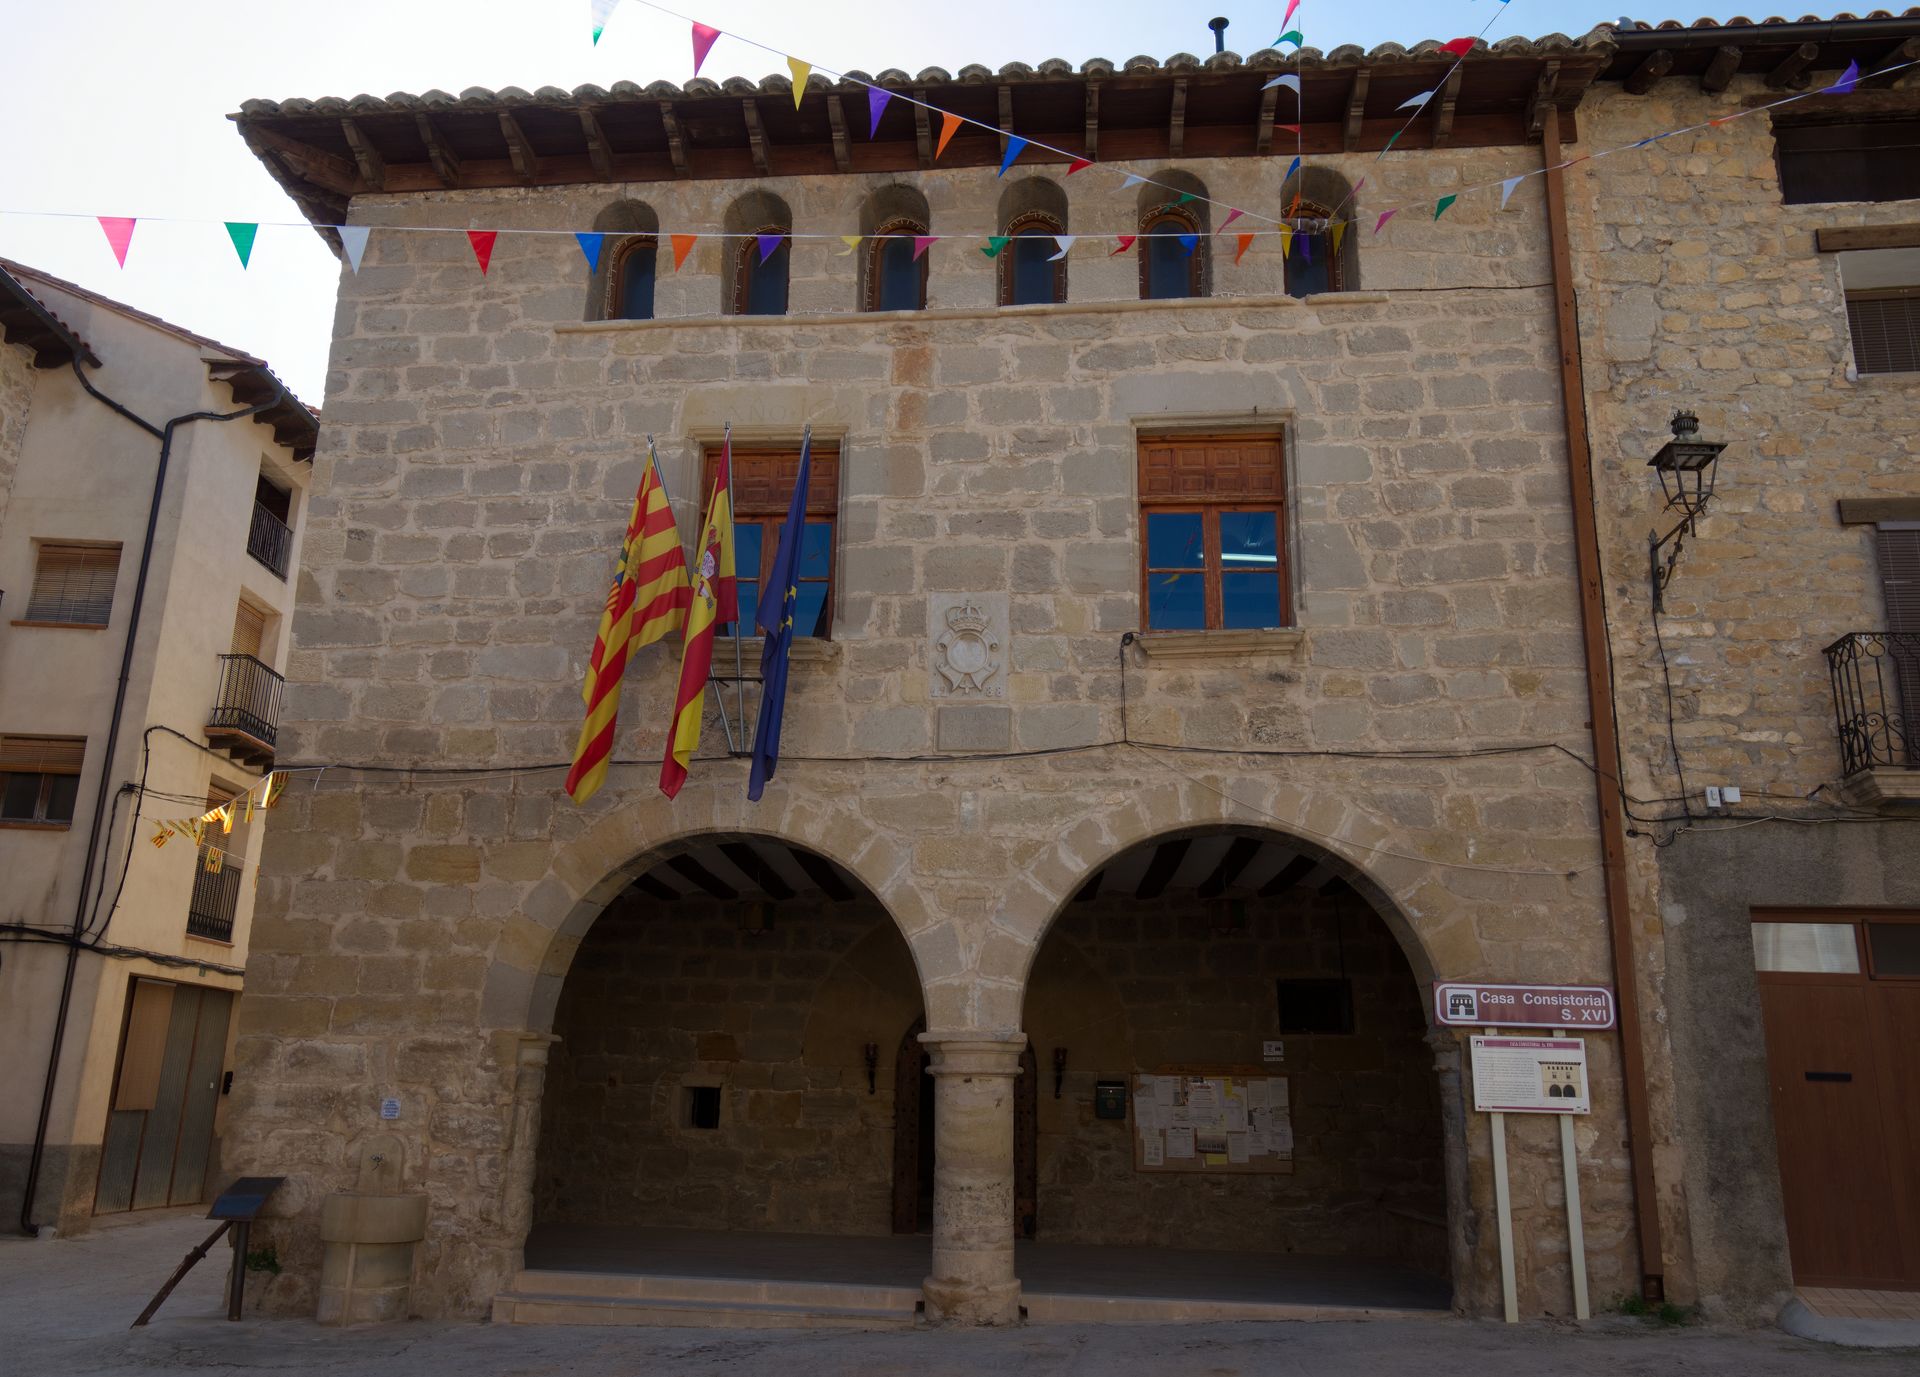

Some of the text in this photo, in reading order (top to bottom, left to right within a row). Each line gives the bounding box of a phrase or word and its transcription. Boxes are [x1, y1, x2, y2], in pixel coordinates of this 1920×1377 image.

[1480, 991, 1606, 1007] Casa Consistorial
[1561, 1008, 1607, 1022] S. XVI
